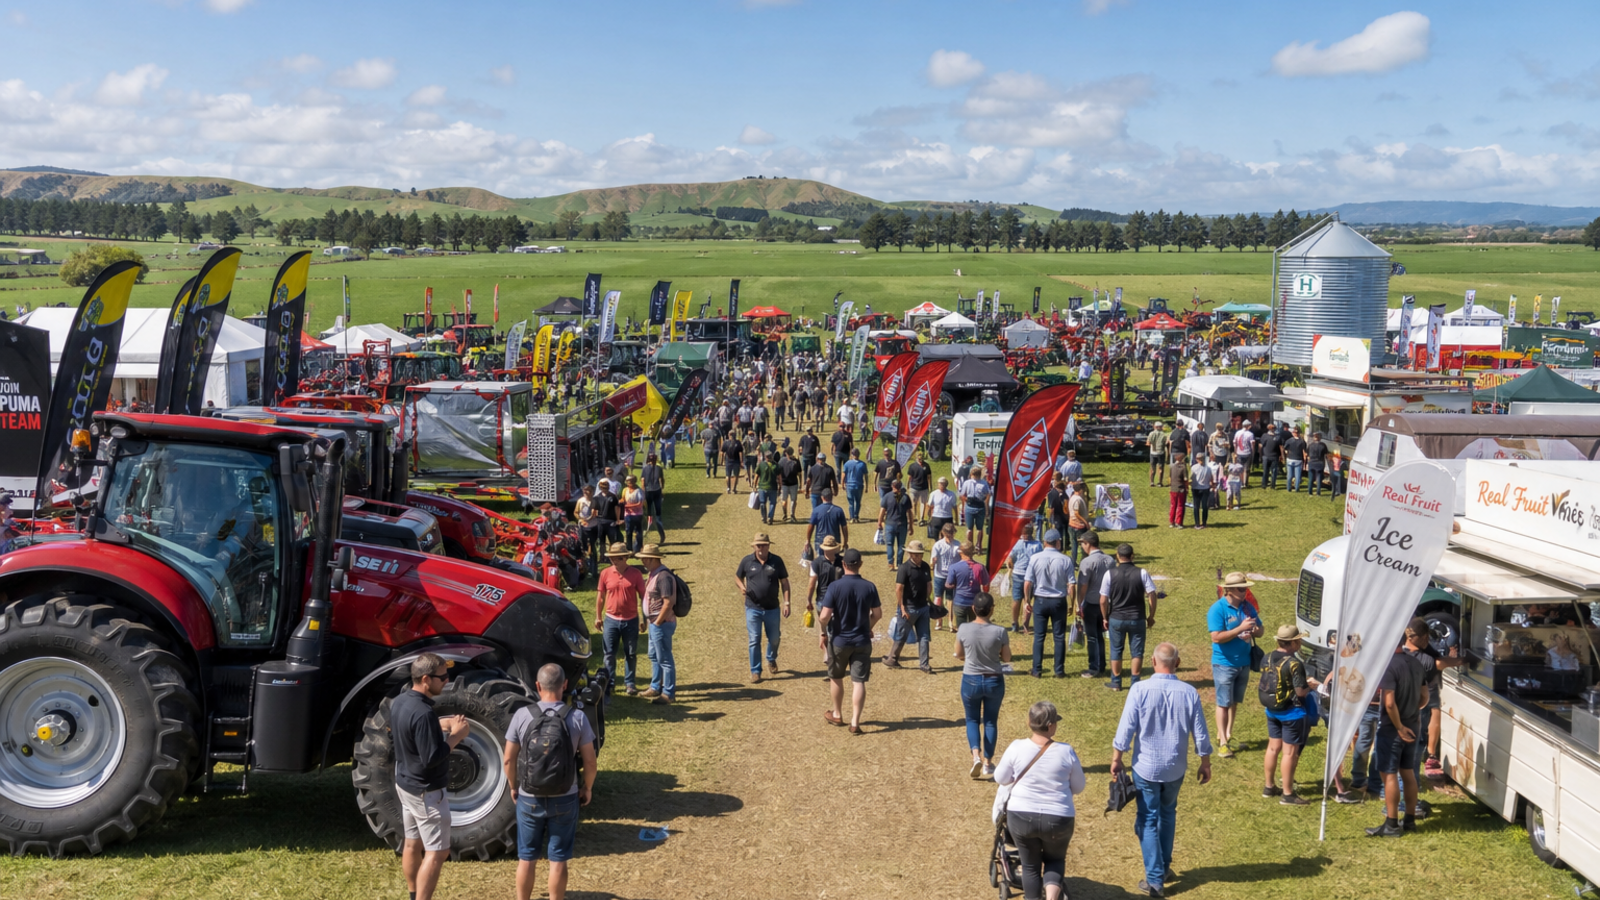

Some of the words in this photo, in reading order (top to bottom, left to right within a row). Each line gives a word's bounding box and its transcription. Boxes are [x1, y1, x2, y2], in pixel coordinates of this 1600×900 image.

[1300, 278, 1312, 291] H
[0, 395, 41, 412] PUMA
[0, 413, 41, 430] TEAM
[1014, 430, 1045, 488] KUHN
[1382, 485, 1409, 504] Real
[1411, 494, 1443, 512] Fruit
[1477, 480, 1511, 507] Real
[1511, 486, 1549, 516] Fruit
[1370, 516, 1414, 551] Ice
[1363, 544, 1422, 577] Cream
[475, 583, 506, 602] 175
